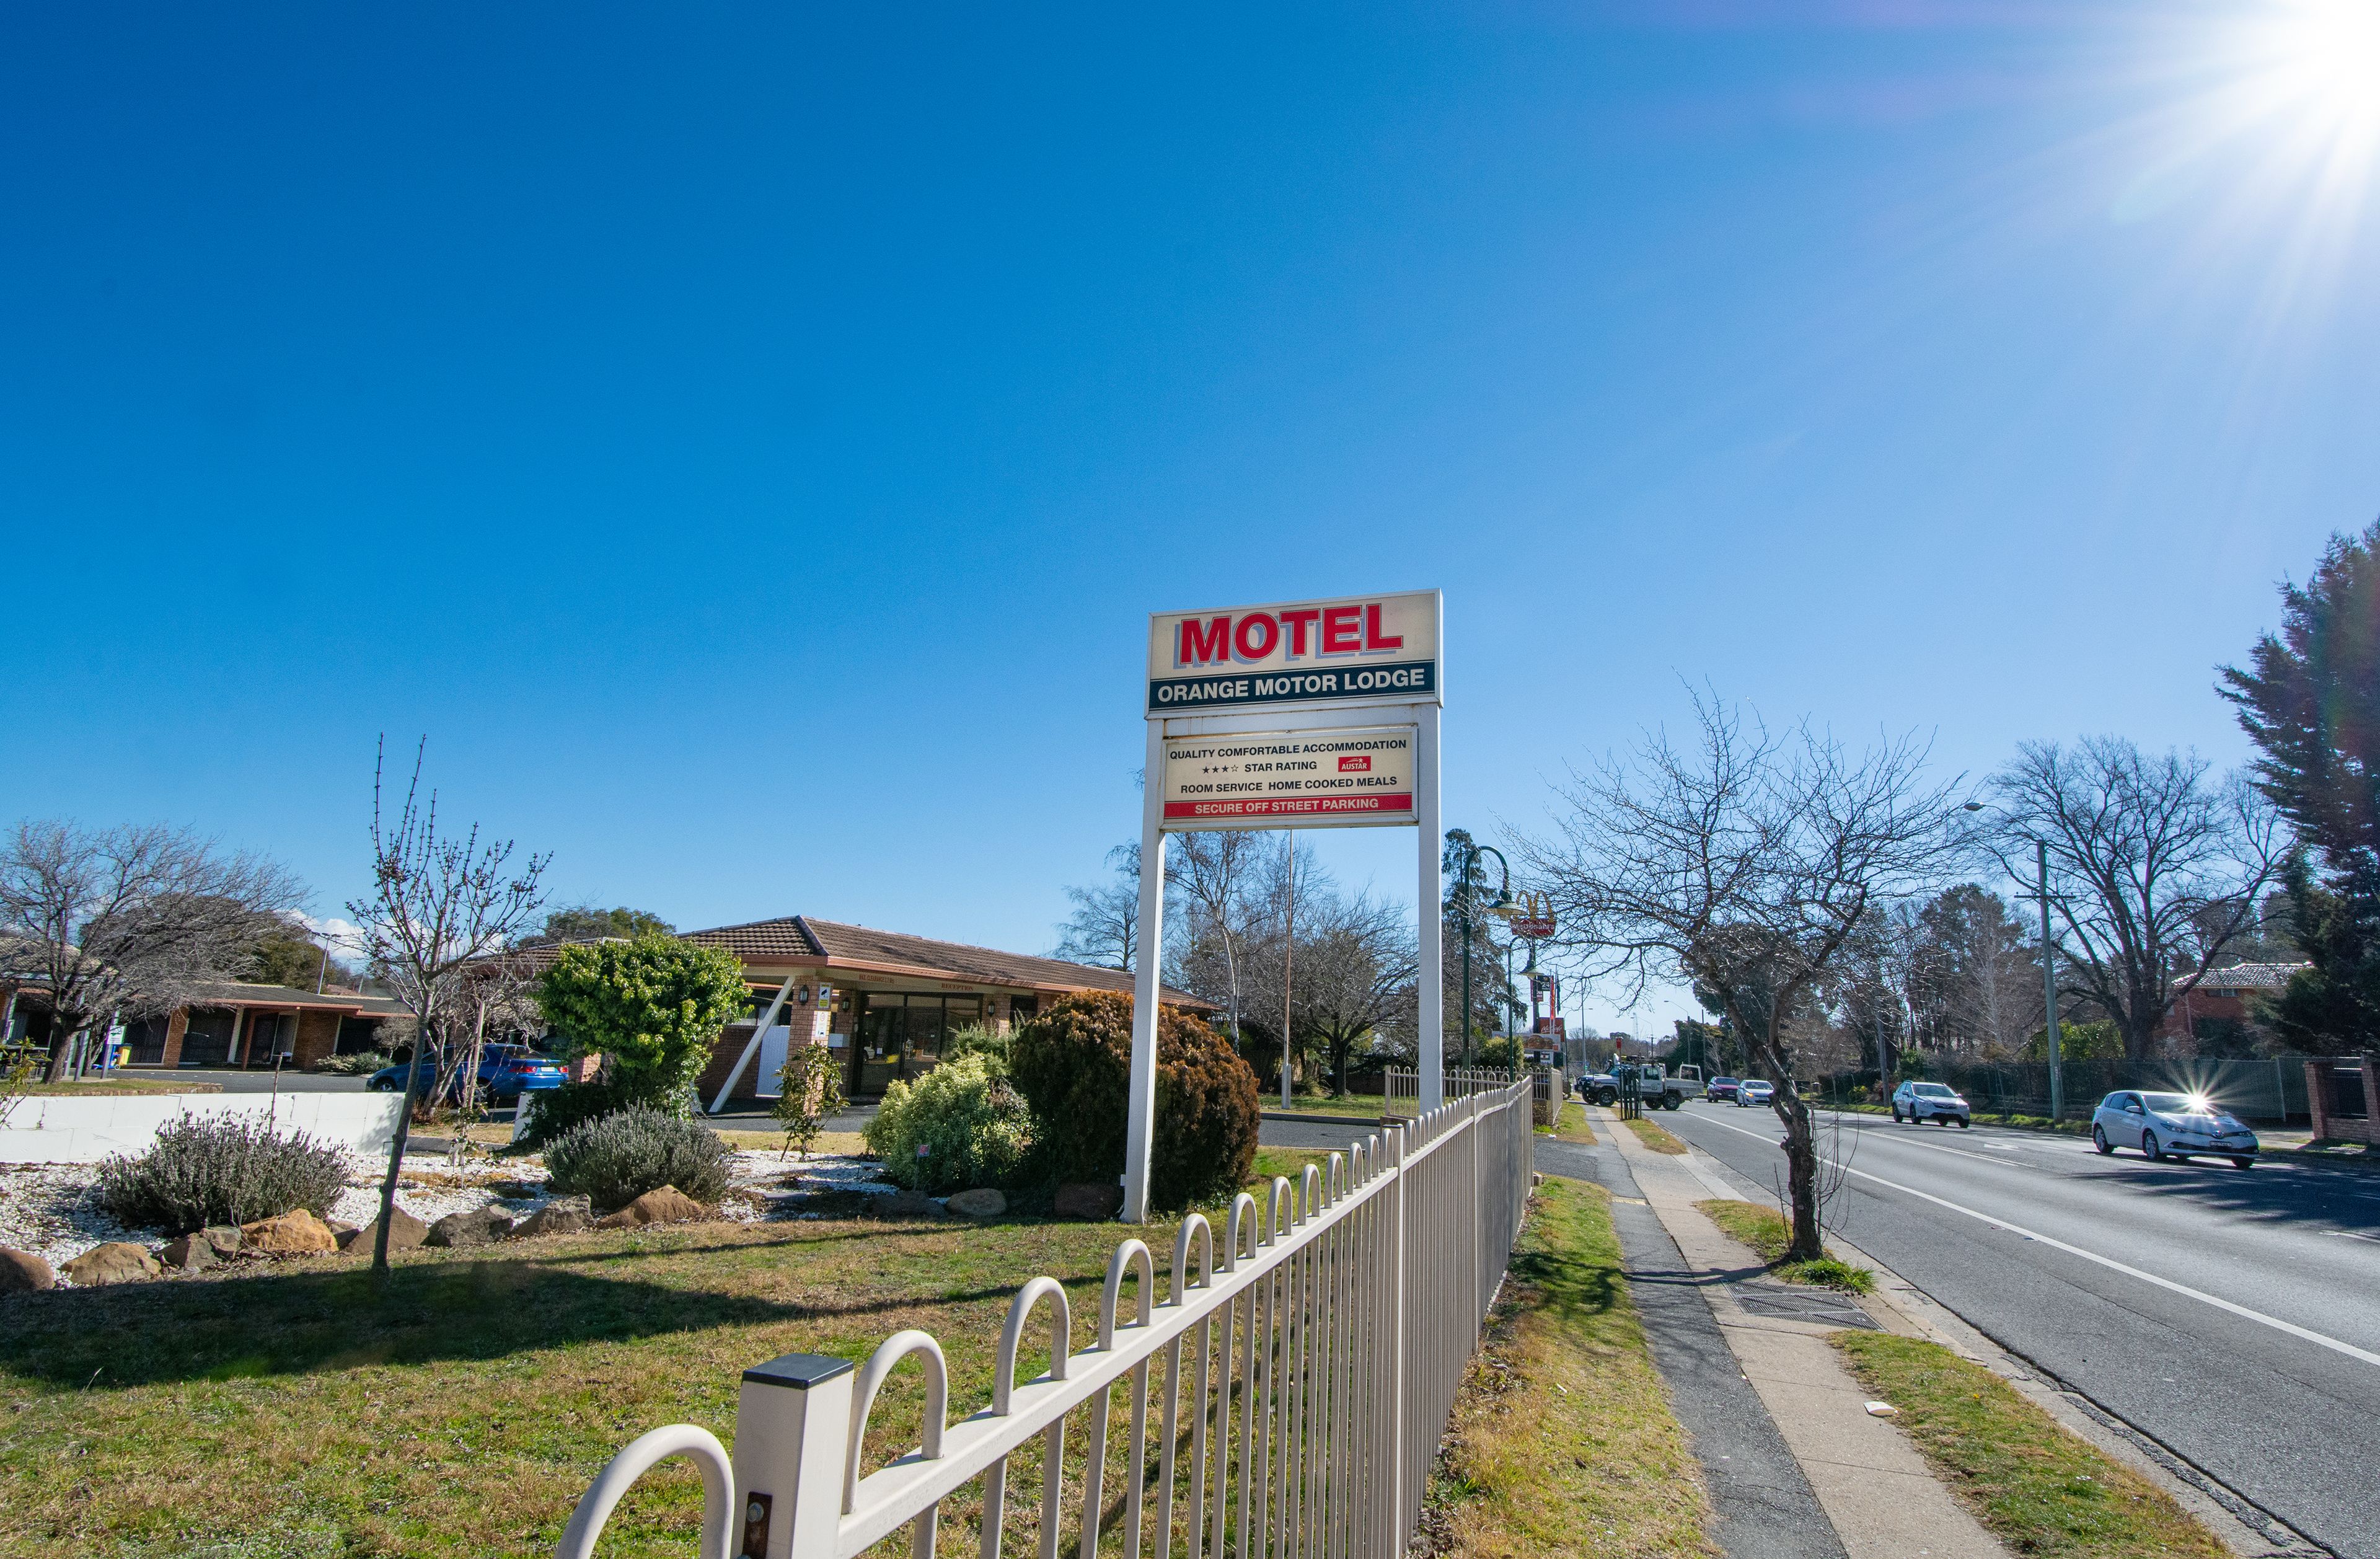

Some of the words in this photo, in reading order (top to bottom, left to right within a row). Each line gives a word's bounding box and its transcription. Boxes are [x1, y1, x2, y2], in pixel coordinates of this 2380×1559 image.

[1179, 603, 1404, 666] MOTEL
[1157, 680, 1249, 702] ORANGE
[1254, 674, 1337, 696] MOTOR
[1344, 668, 1426, 690] LODGE
[1170, 749, 1215, 760] QUALITY
[1217, 744, 1300, 757] COMFORTABLE
[1302, 740, 1407, 753] ACCOMMODATION
[1244, 763, 1273, 772] STAR
[1276, 761, 1318, 771] RATING
[1180, 784, 1214, 793] ROOM
[1215, 782, 1263, 793] SERVICE
[1268, 780, 1302, 790] HOME
[1305, 779, 1354, 789] COOKED
[1356, 776, 1398, 787] MEALS
[1194, 803, 1243, 815] SECURE
[1245, 802, 1269, 813] OFF
[1271, 800, 1320, 812] STREET
[1322, 798, 1379, 810] PARKING
[941, 983, 973, 991] RECEPTION
